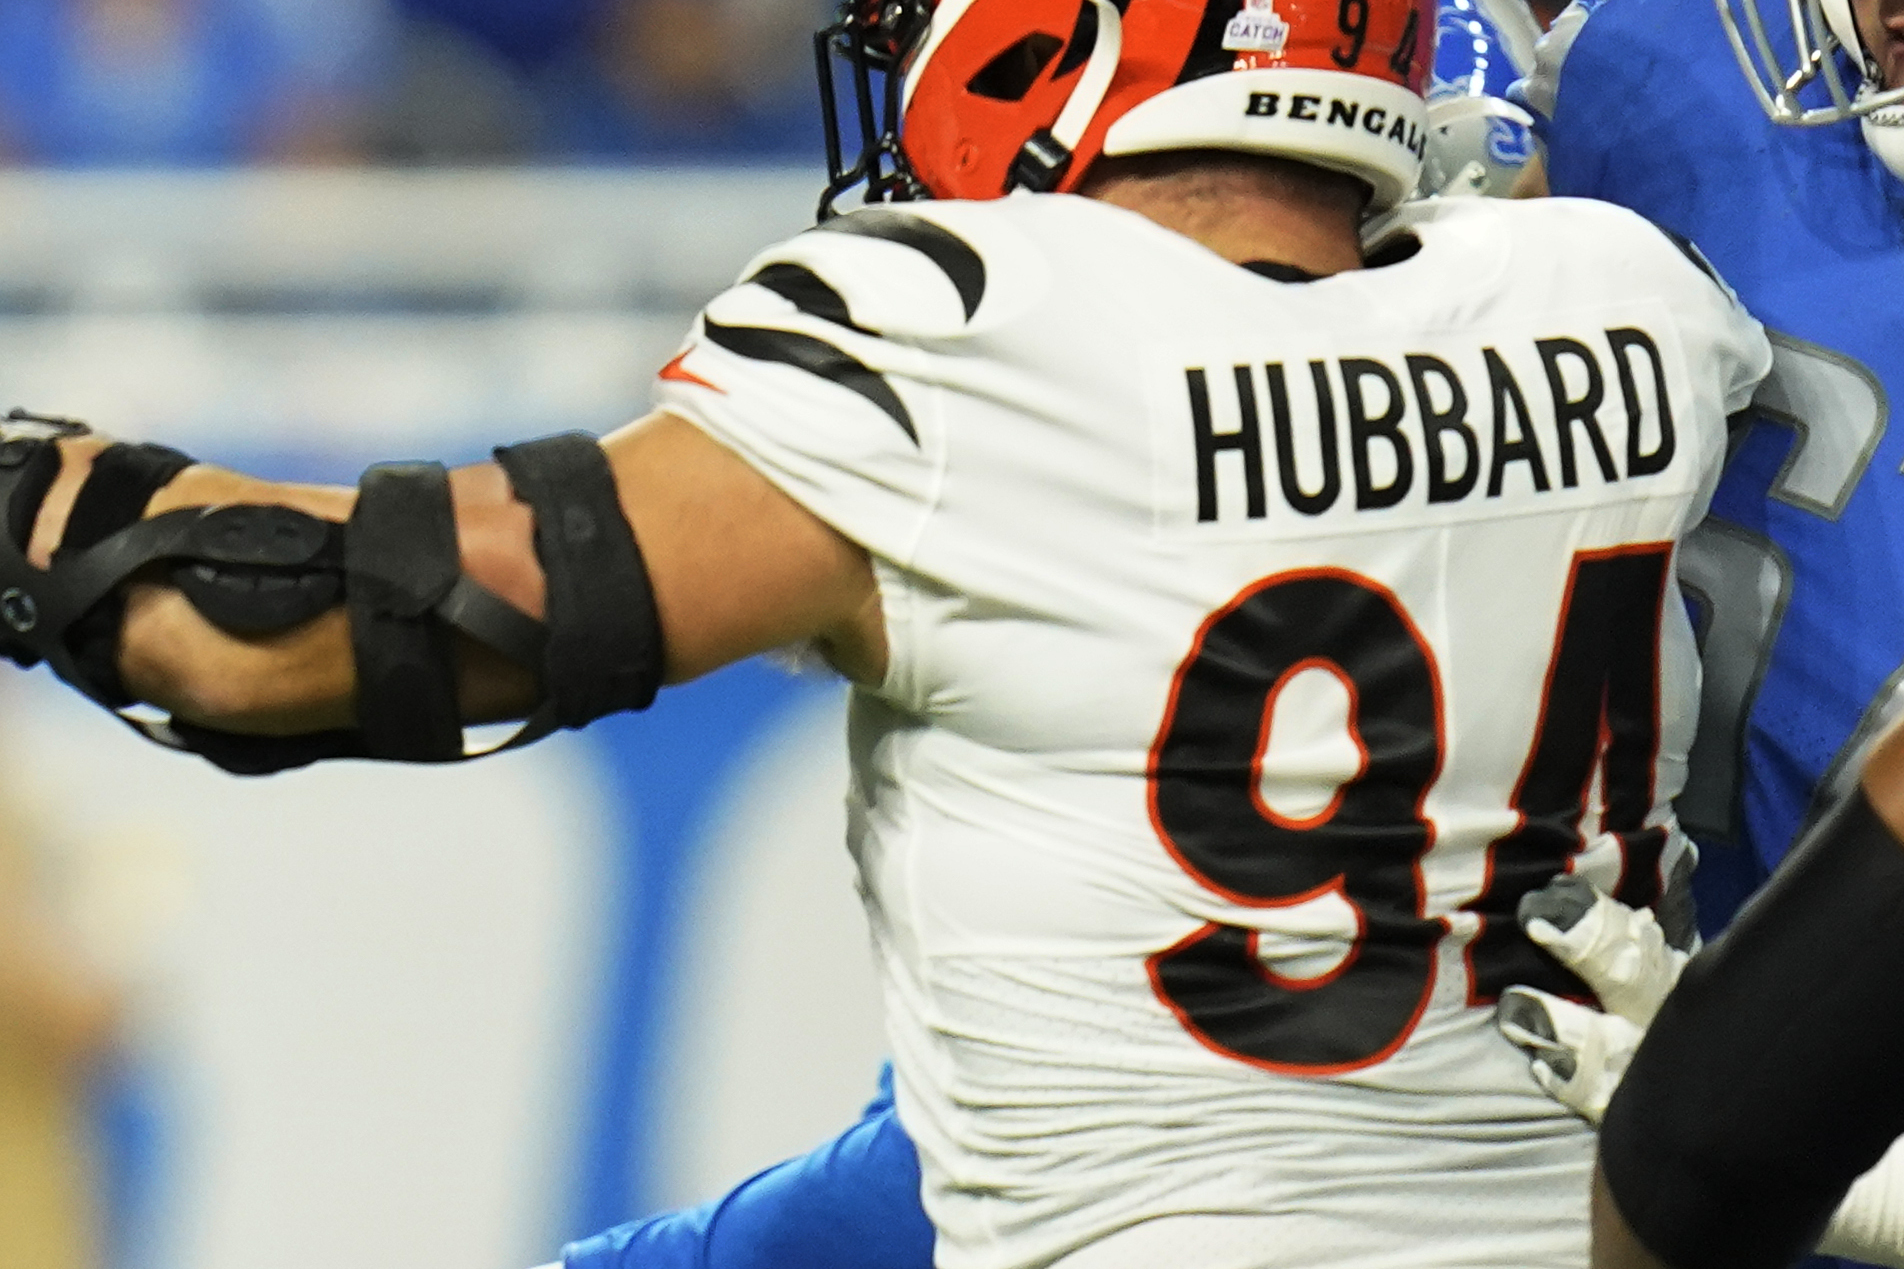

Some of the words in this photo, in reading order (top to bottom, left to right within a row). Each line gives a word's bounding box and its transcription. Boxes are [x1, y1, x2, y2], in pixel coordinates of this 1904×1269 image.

[1229, 22, 1284, 40] CATCH
[1185, 326, 1677, 522] HUBBARD
[1147, 540, 1676, 1077] 94
